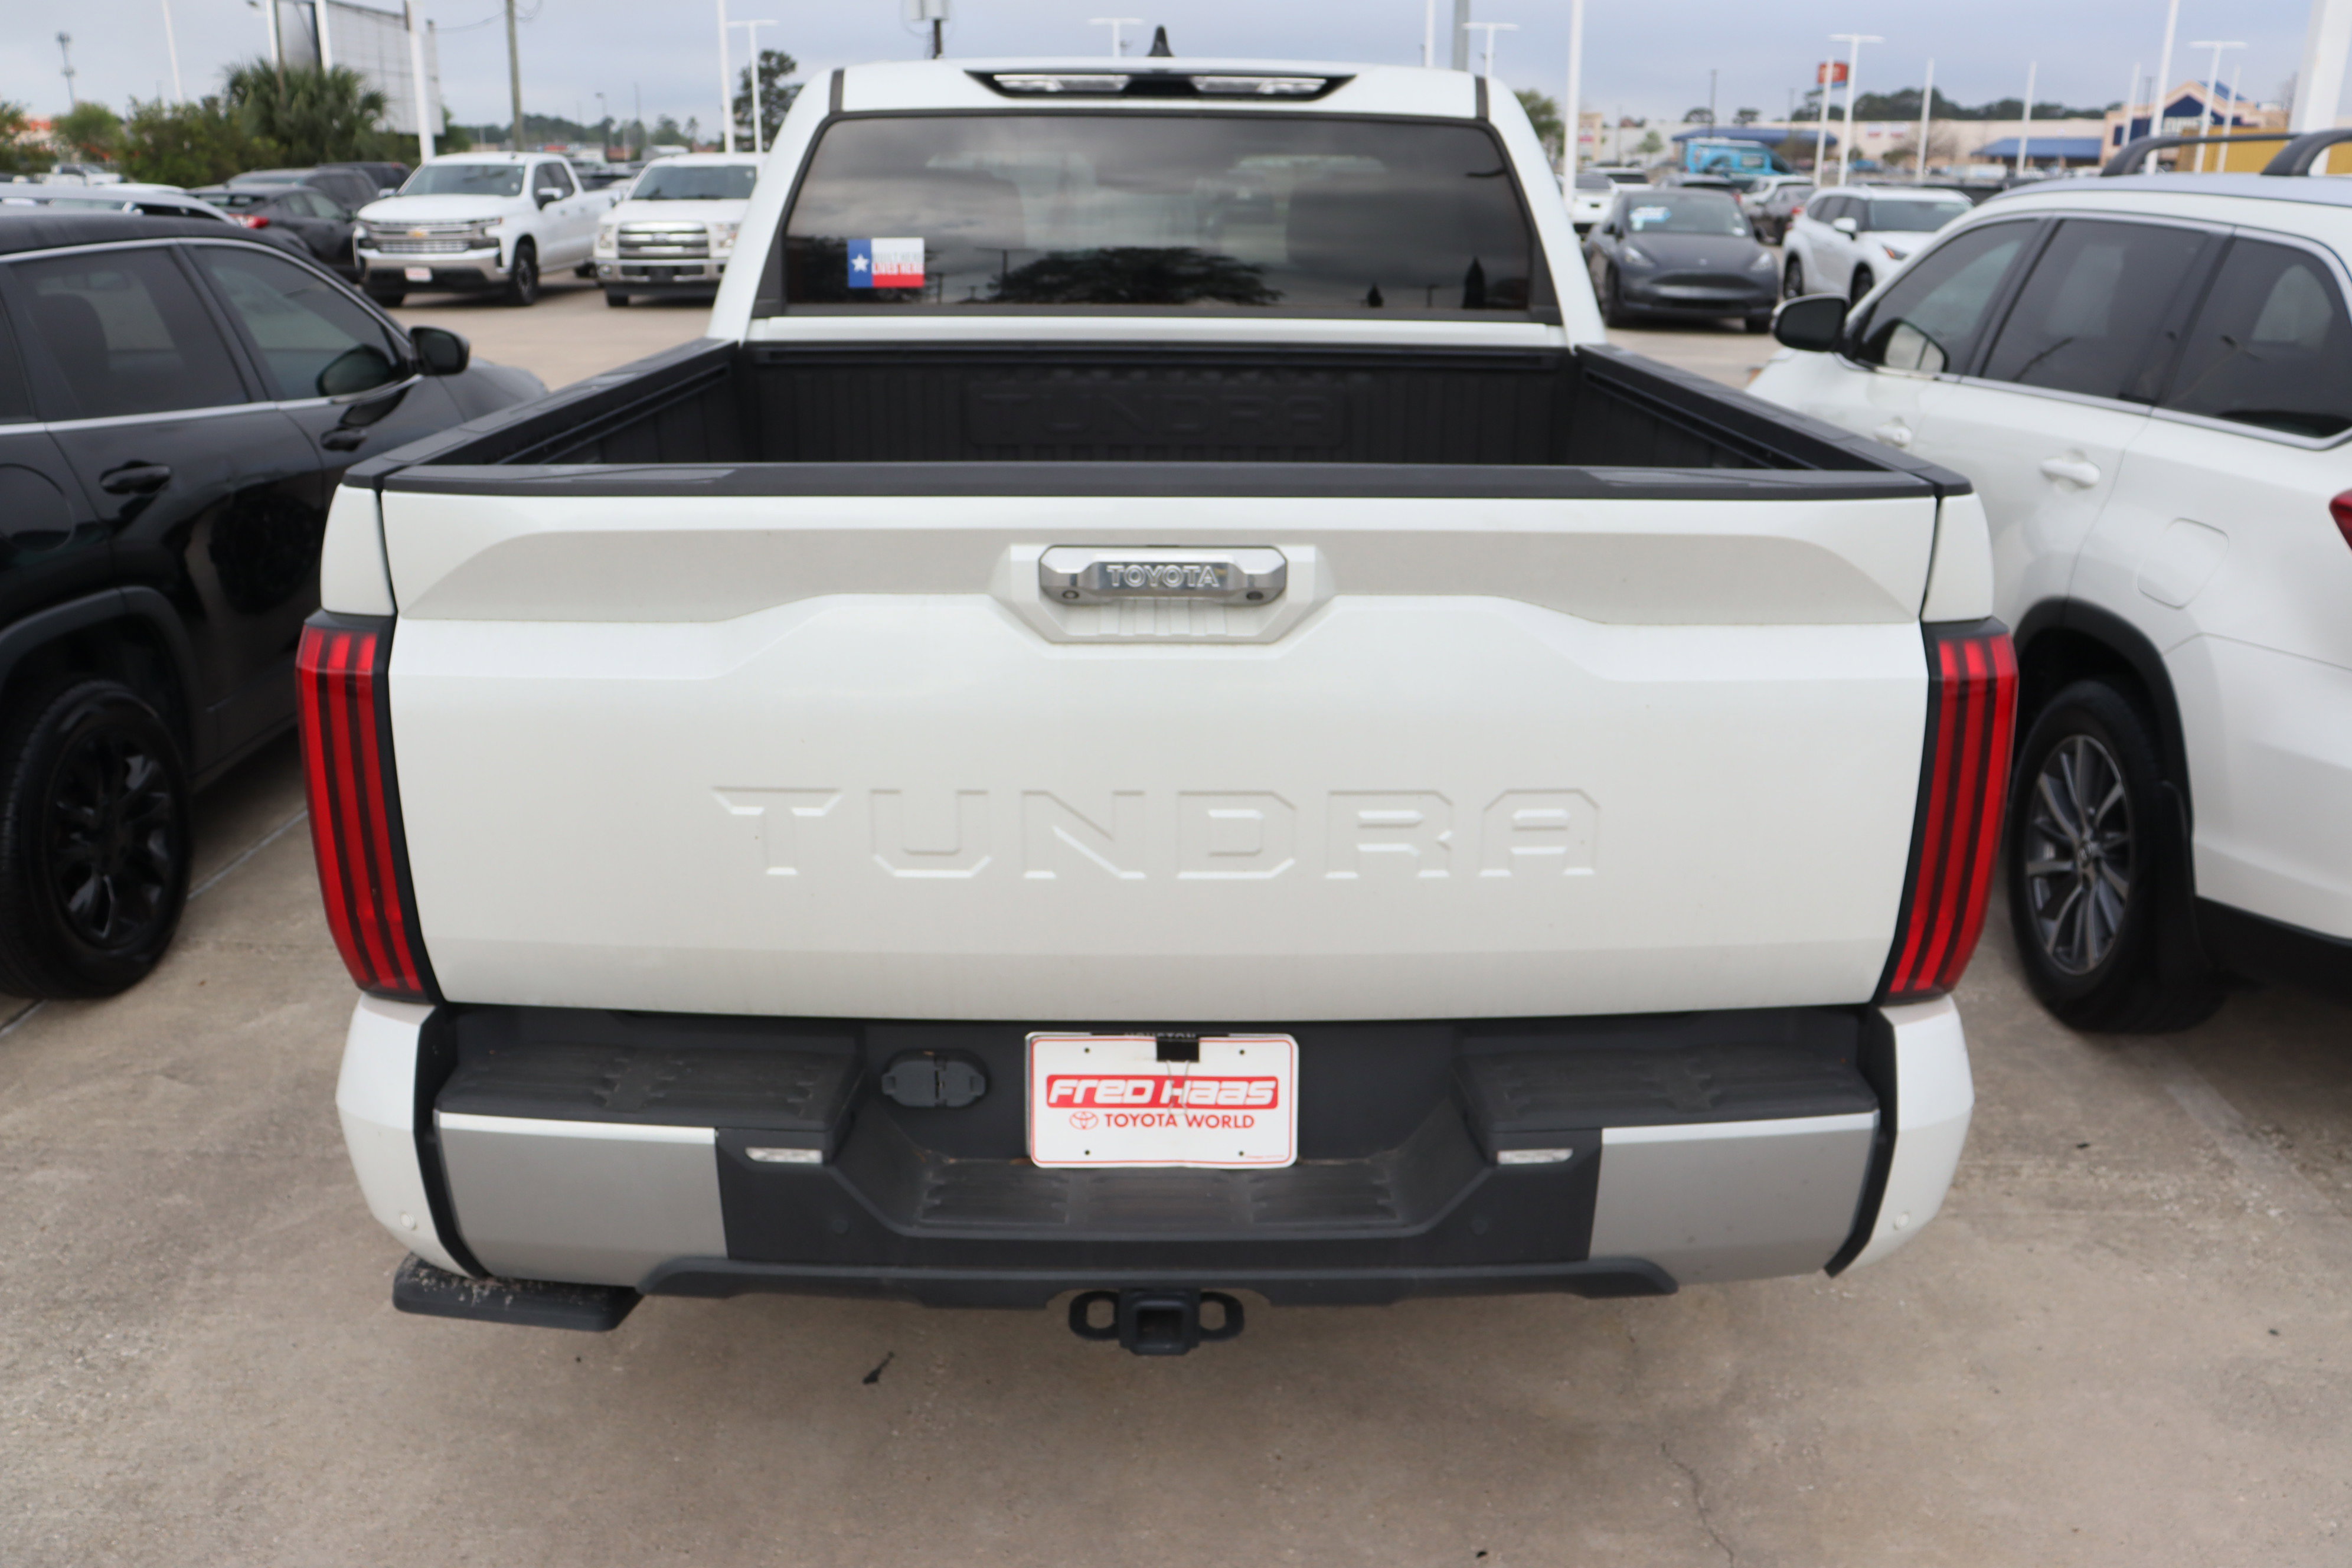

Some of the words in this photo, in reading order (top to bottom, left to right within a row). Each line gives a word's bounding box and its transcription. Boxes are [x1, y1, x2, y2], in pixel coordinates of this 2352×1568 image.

[979, 392, 1333, 435] TUNDRA
[1106, 564, 1220, 589] TOYOTA
[710, 785, 1601, 879] TUNDRA
[1105, 1113, 1178, 1128] TOYOTA
[1184, 1114, 1255, 1129] WORLD
